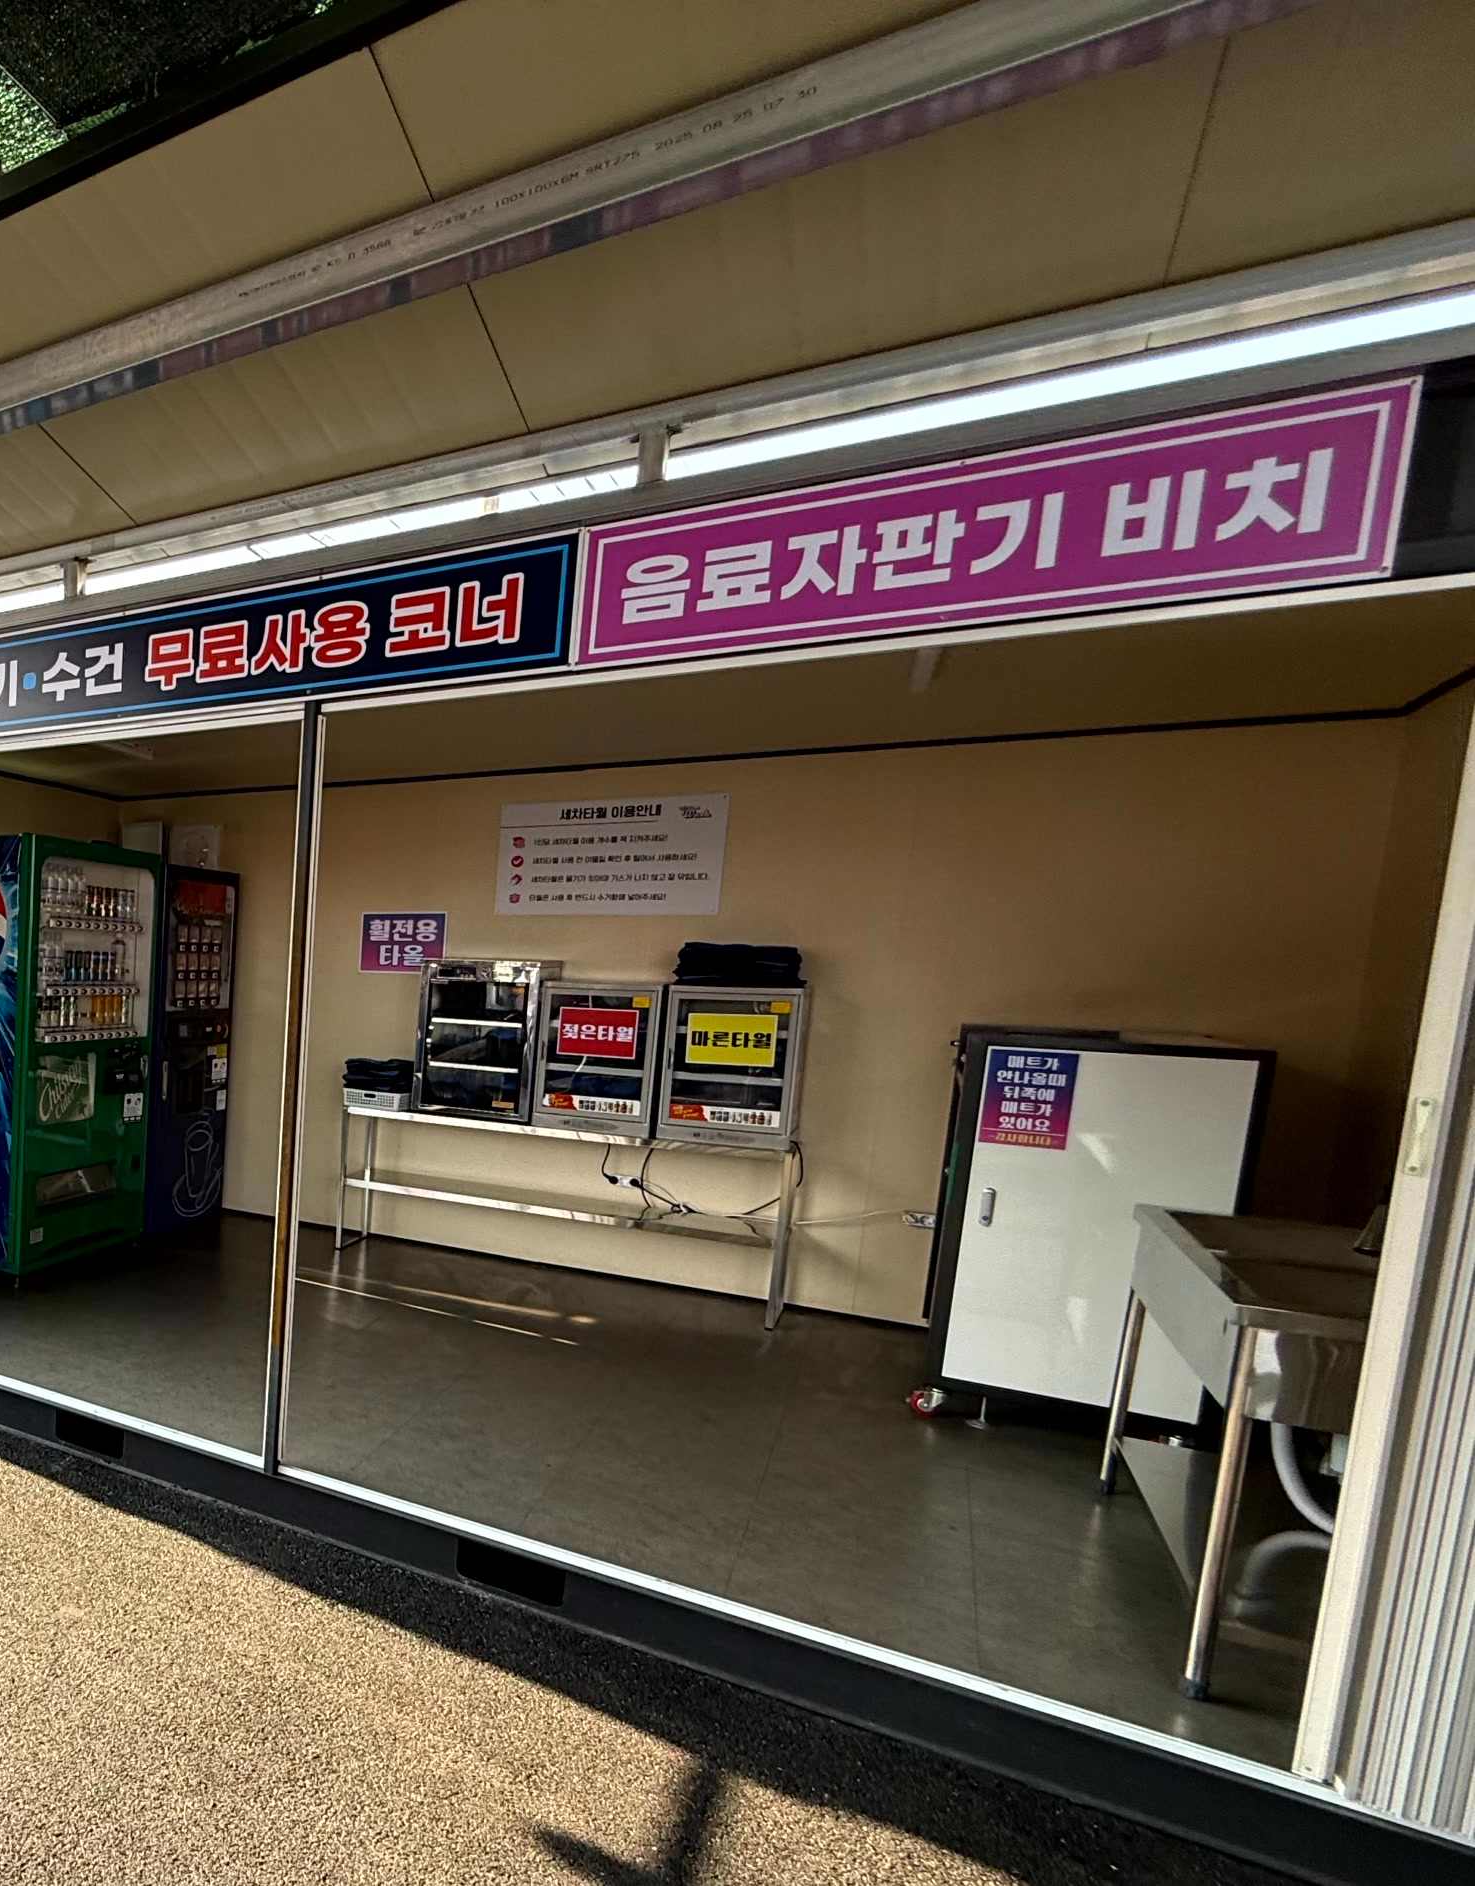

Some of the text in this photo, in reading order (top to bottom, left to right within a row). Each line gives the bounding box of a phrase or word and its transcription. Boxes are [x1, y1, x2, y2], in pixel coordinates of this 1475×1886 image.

[620, 447, 1335, 625] 음료자판기 비치
[143, 600, 371, 690] 무료사용
[384, 572, 525, 658] 코너
[559, 804, 662, 820] 세차타월 이용안내
[368, 919, 439, 942] 휠전용
[379, 944, 425, 967] 타올
[561, 1022, 634, 1044] 젖은타월
[690, 1029, 772, 1050] 마른타월
[1007, 1055, 1060, 1071] 매트가
[996, 1070, 1067, 1087] 안나올때
[1002, 1085, 1056, 1102] 뒤쪽에
[1000, 1101, 1053, 1116] 매트가
[998, 1115, 1051, 1132] 있어요
